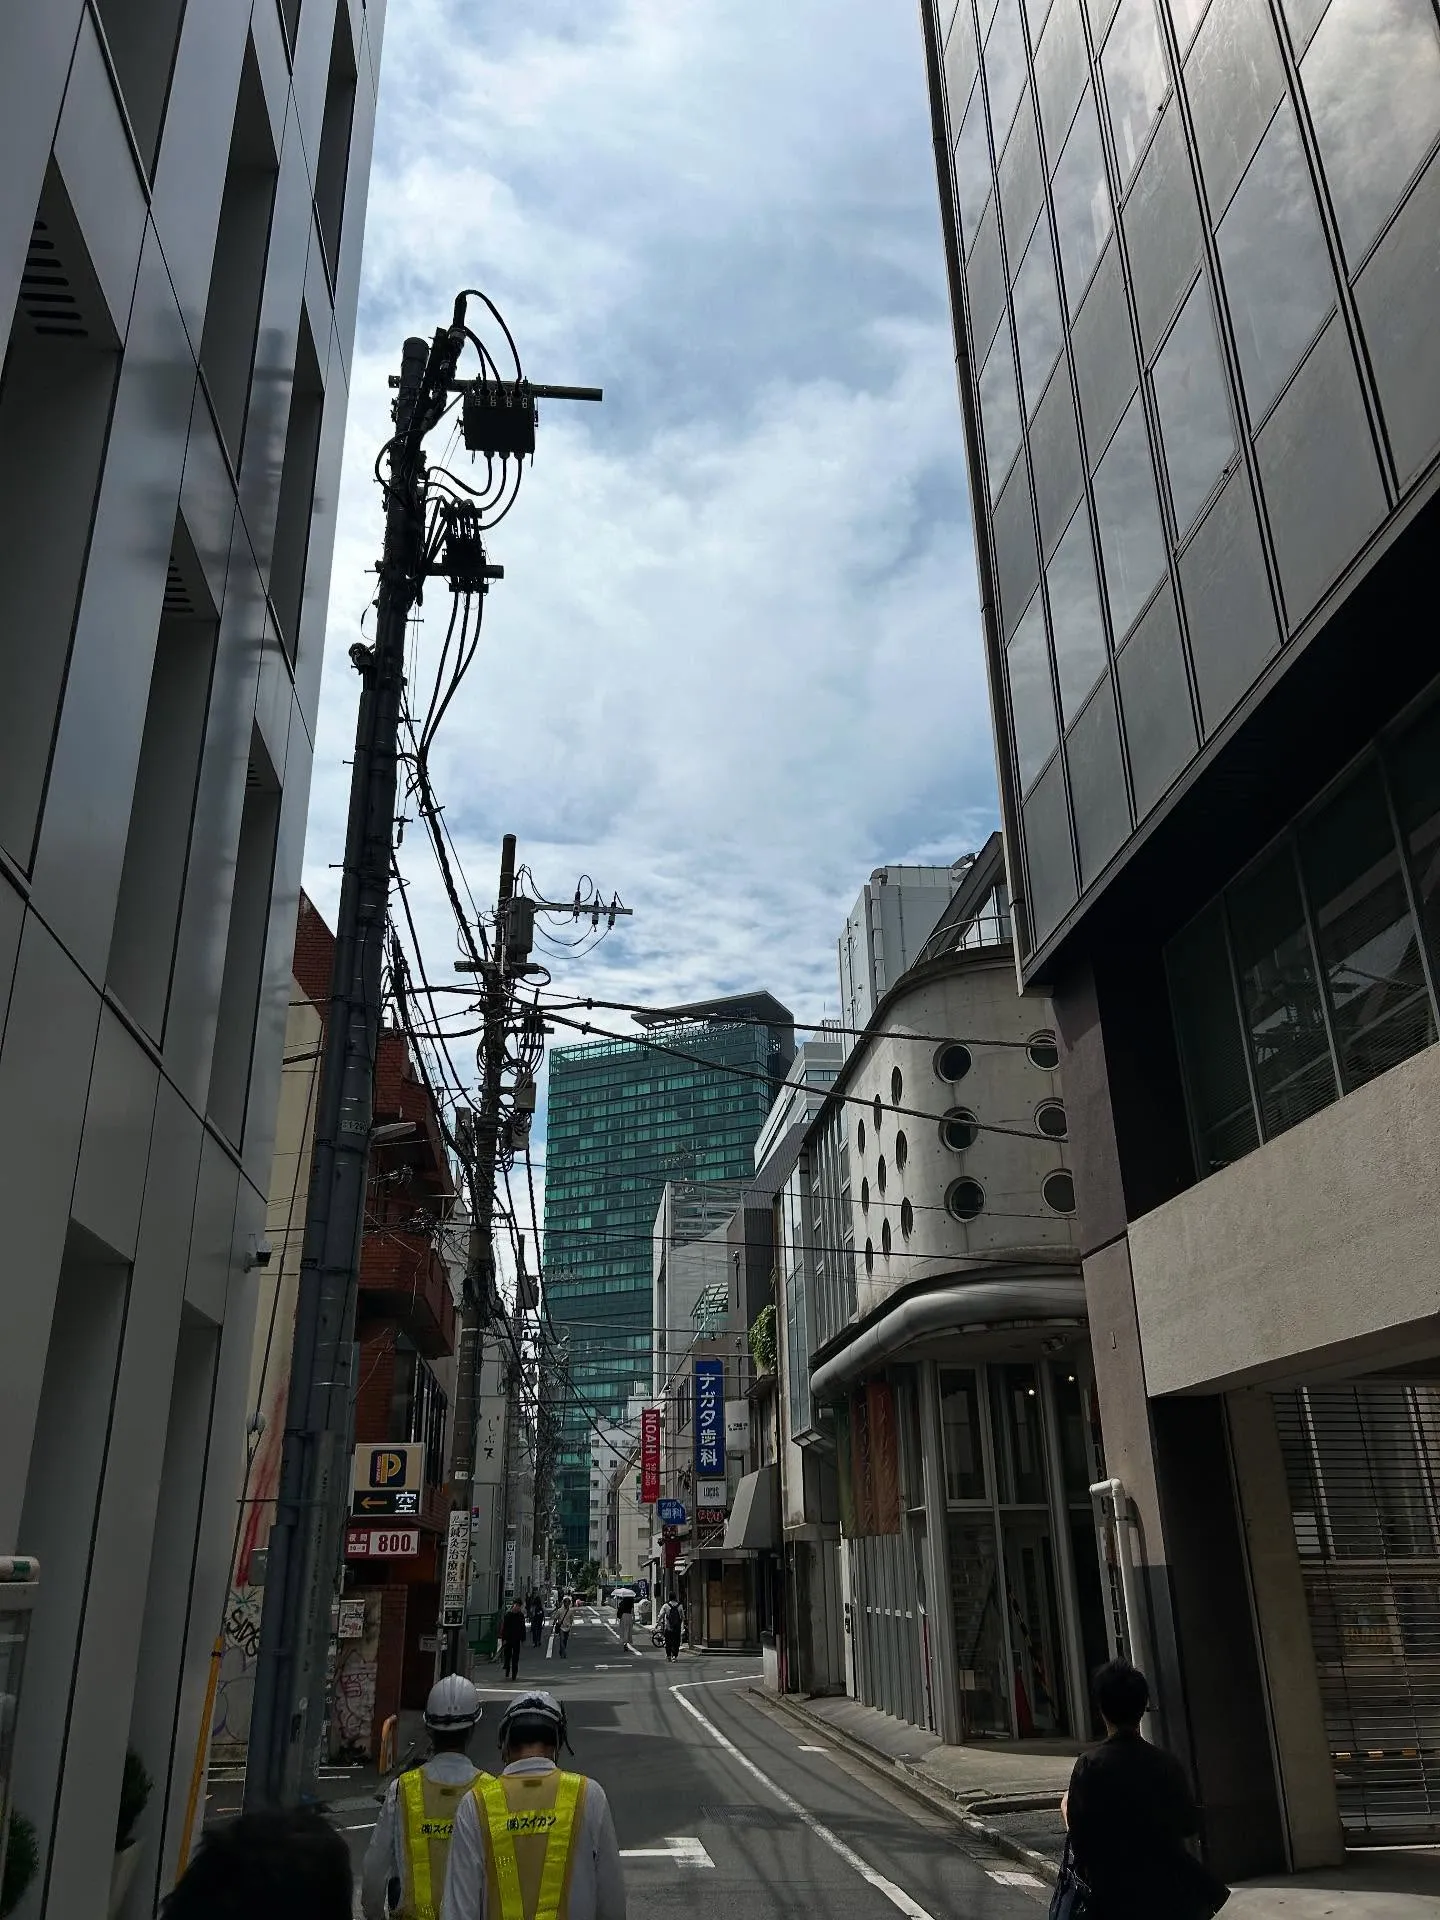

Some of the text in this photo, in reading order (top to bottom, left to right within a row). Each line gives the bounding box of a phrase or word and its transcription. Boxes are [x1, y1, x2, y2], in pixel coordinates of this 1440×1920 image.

[700, 1373, 718, 1467] ナガタ歯科
[645, 1413, 657, 1455] NOAH
[394, 1491, 417, 1513] 空
[661, 1507, 682, 1519] 歯科
[506, 1816, 557, 1830] (株)スイカン
